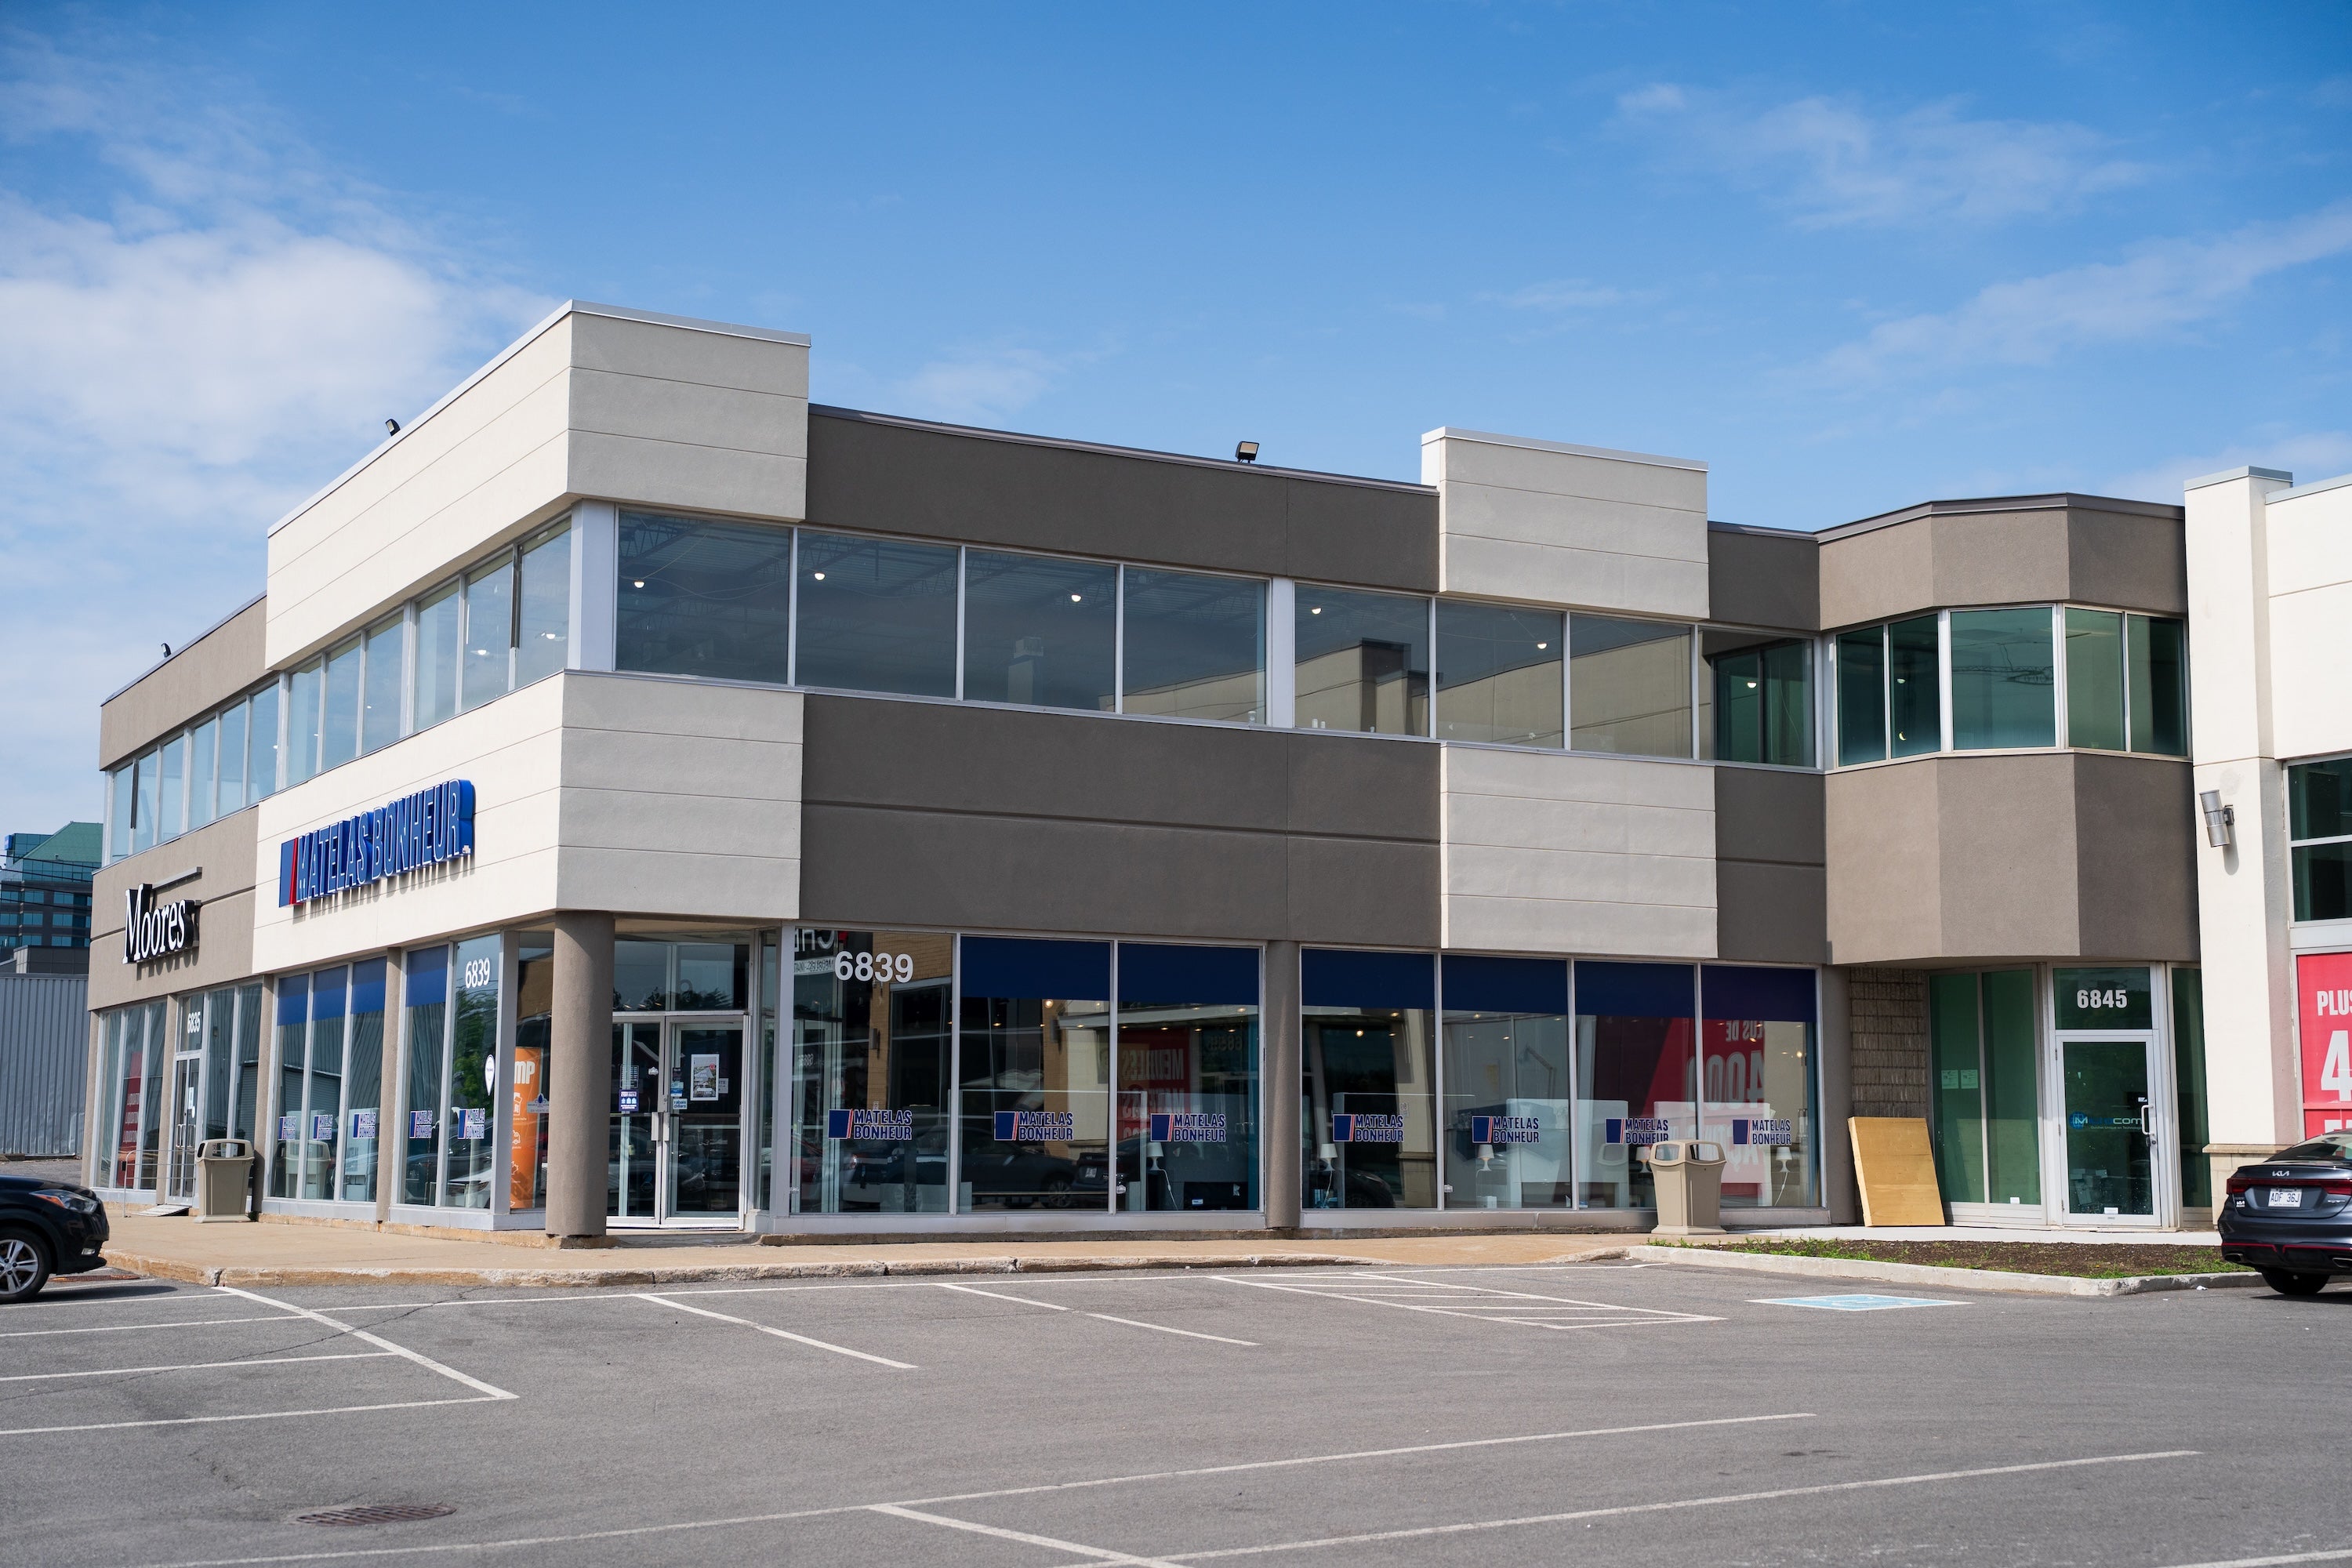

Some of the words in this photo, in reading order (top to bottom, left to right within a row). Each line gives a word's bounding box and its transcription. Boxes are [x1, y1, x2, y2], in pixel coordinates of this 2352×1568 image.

[296, 811, 369, 903] MATELAS
[371, 779, 464, 881] BONHEUR
[122, 883, 186, 964] Moores
[465, 957, 491, 989] 6839
[834, 950, 913, 983] 6839
[2076, 989, 2128, 1009] 6845
[2317, 989, 2352, 1016] PLU
[187, 1011, 201, 1034] 6835
[854, 1109, 912, 1124] MATELAS
[1018, 1112, 1073, 1126] MATELAS
[1174, 1113, 1225, 1127] MATELAS
[1355, 1115, 1403, 1128] MATELAS
[1493, 1116, 1539, 1130] MATELAS
[1625, 1119, 1669, 1131] MATELAS
[1751, 1120, 1791, 1131] MATELAS
[854, 1125, 912, 1140] BONHEUR
[1018, 1127, 1074, 1141] BONHEUR
[1174, 1128, 1226, 1142] BONHEUR
[1355, 1129, 1405, 1142] BONHEUR
[1493, 1131, 1541, 1143] BONHEUR
[1625, 1132, 1669, 1145] BONHEUR
[1752, 1133, 1791, 1145] BONHEUR
